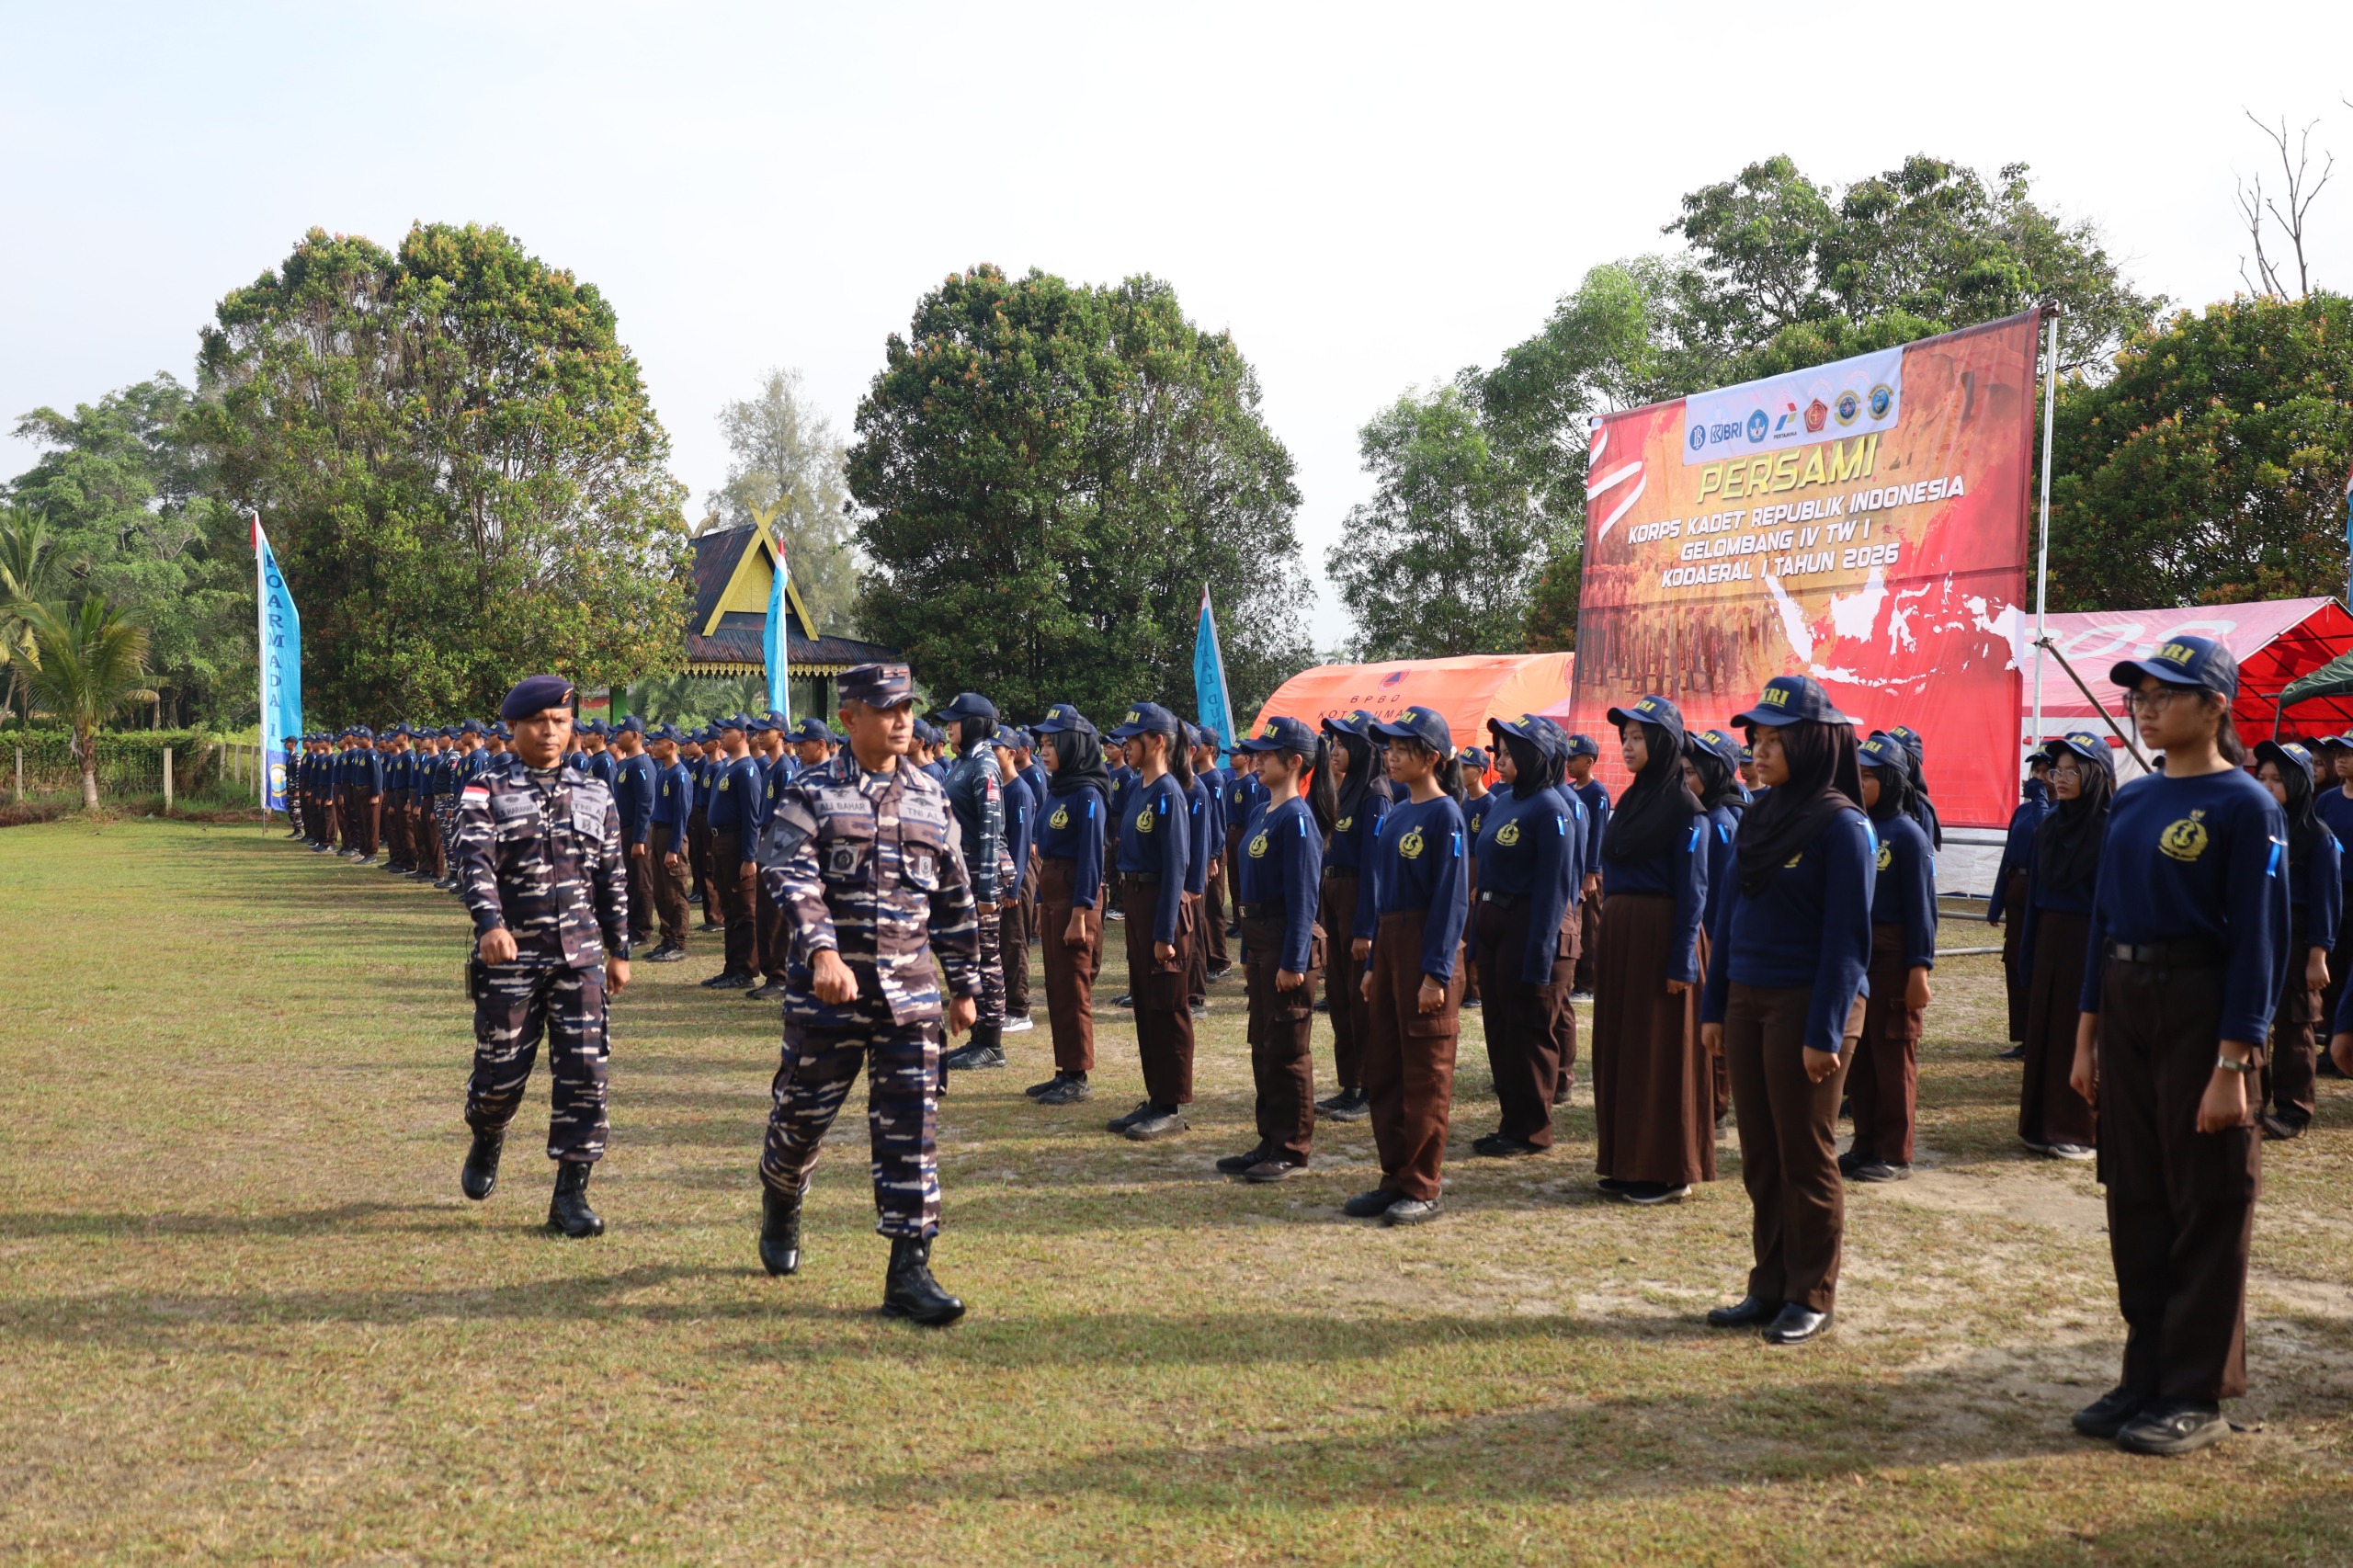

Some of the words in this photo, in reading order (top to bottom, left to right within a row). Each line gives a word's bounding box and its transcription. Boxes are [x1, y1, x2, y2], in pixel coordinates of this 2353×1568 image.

[1723, 421, 1743, 441] BRI
[1773, 430, 1798, 440] PERTAMINA
[1696, 433, 1879, 503] PERSAMI
[1628, 518, 1680, 545] KORPS
[1687, 510, 1746, 536] KADET
[1751, 494, 1846, 528] REPUBLIK
[1848, 475, 1965, 515] INDONESIA
[1680, 530, 1794, 562] GELOMBANG
[1799, 527, 1819, 548] IV
[1825, 520, 1858, 544] TW
[1863, 517, 1870, 540] I
[1661, 562, 1753, 588] KODAERAL
[1760, 557, 1768, 579] I
[1775, 551, 1836, 577] TAHUN
[1843, 543, 1900, 569] 2026
[1350, 694, 1401, 703] BPBD
[820, 802, 834, 812] ALI
[836, 801, 866, 811] BAHAR
[907, 807, 924, 816] TNI
[926, 811, 941, 821] AL
